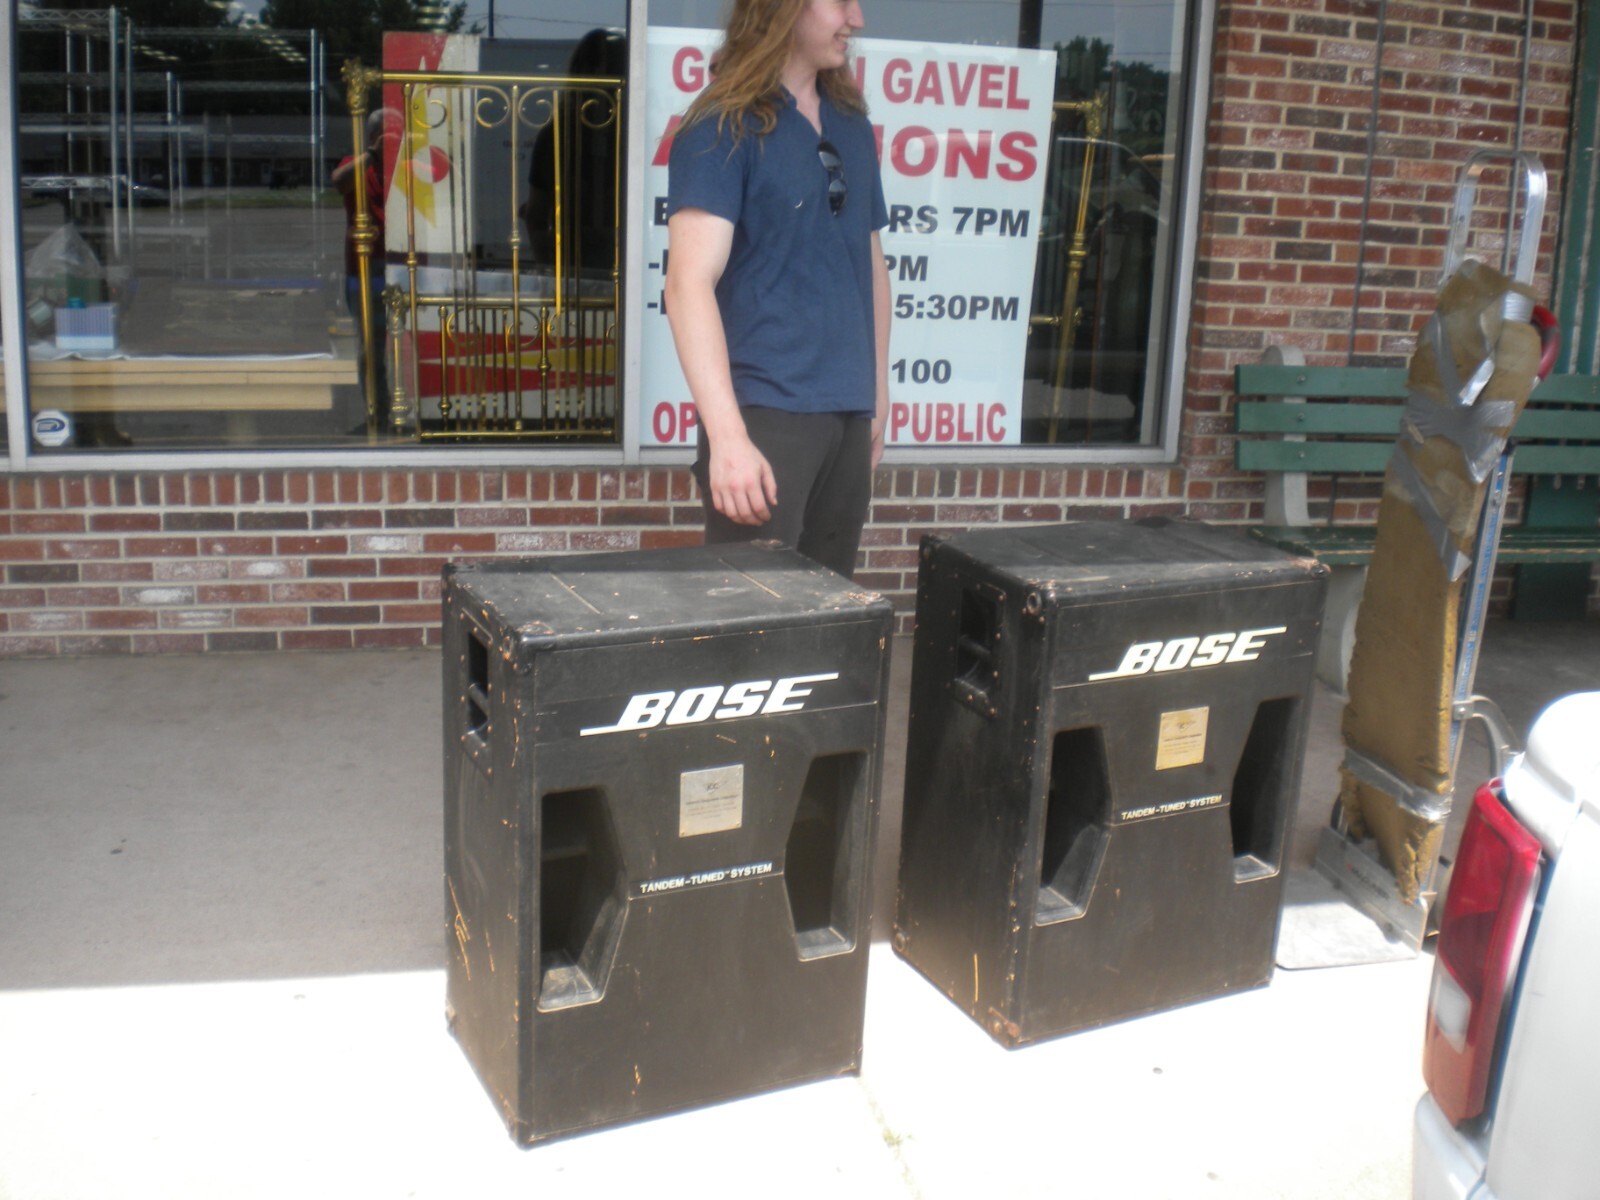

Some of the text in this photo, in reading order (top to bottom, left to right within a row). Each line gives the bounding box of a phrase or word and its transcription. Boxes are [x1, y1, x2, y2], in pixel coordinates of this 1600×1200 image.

[882, 57, 1030, 110] GAVEL
[952, 206, 1031, 238] 7PM
[894, 293, 1020, 322] 5:30PM
[891, 358, 952, 385] 100
[890, 402, 1007, 443] PUBLIC
[1088, 626, 1288, 682] BOSE
[579, 672, 840, 737] BOSE
[1188, 794, 1223, 808] SYSTEM
[729, 862, 773, 879] SYSTEM
